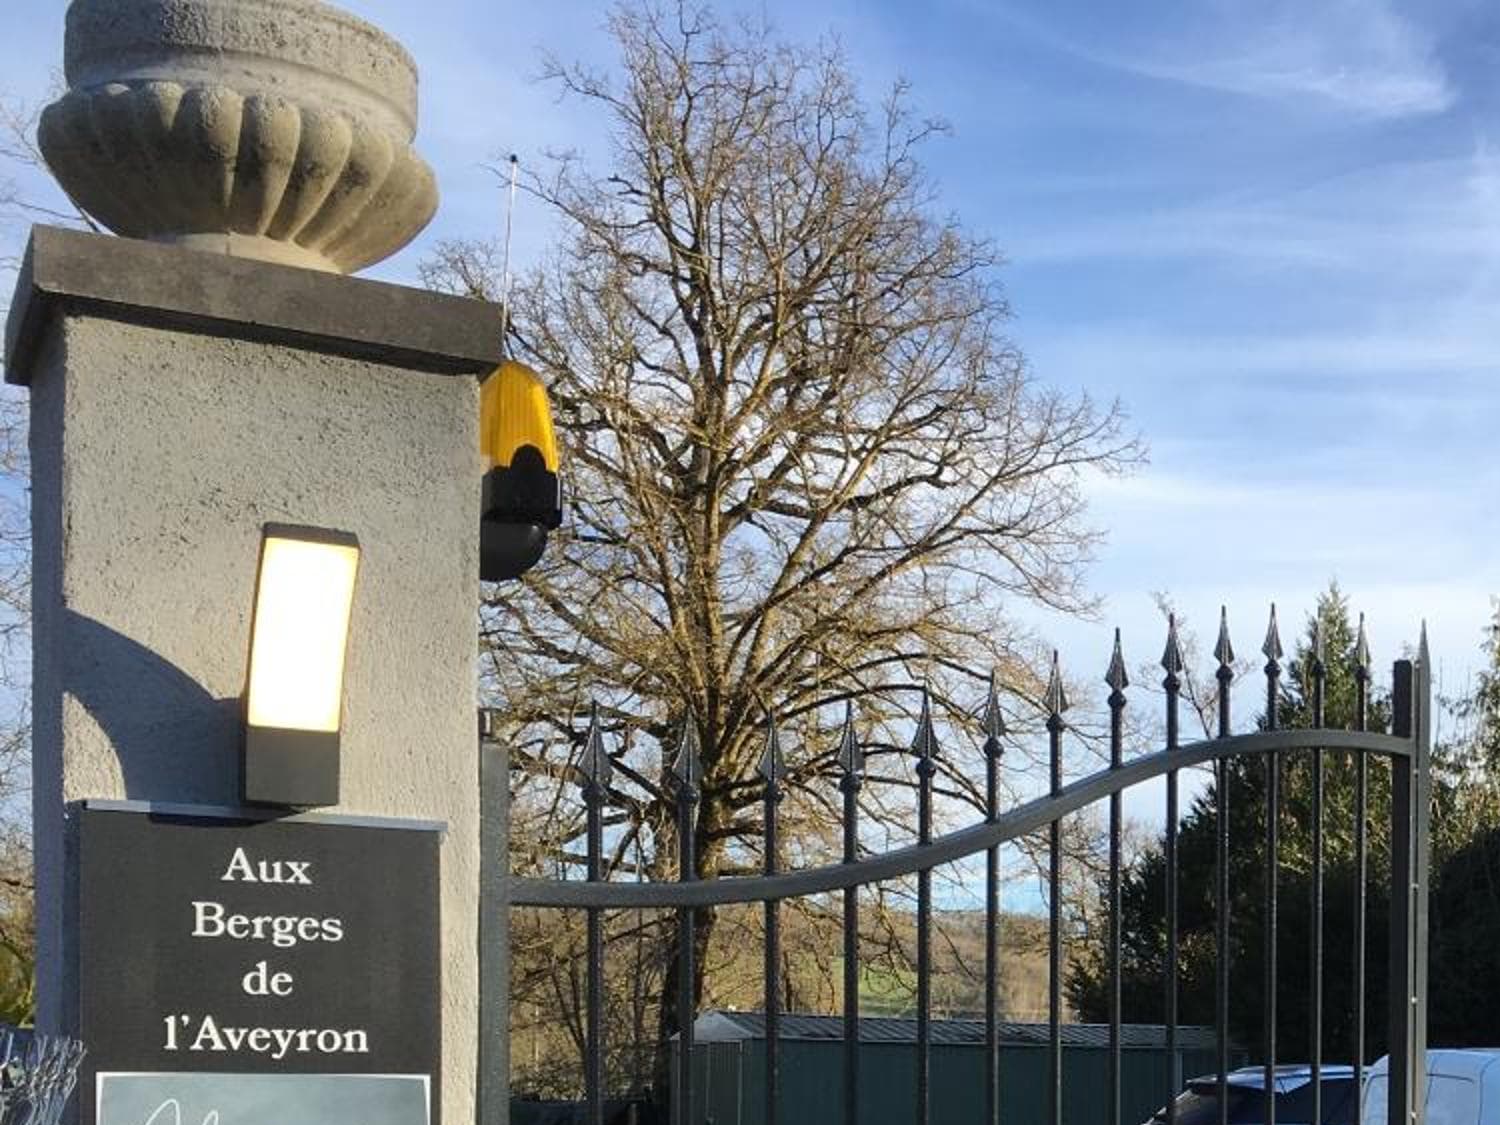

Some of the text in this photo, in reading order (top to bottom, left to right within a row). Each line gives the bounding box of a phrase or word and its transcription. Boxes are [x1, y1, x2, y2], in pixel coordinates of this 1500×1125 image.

[220, 847, 313, 885] Aux
[191, 901, 344, 948] Berges
[242, 960, 294, 996] de
[163, 1014, 369, 1060] l'Aveyron
